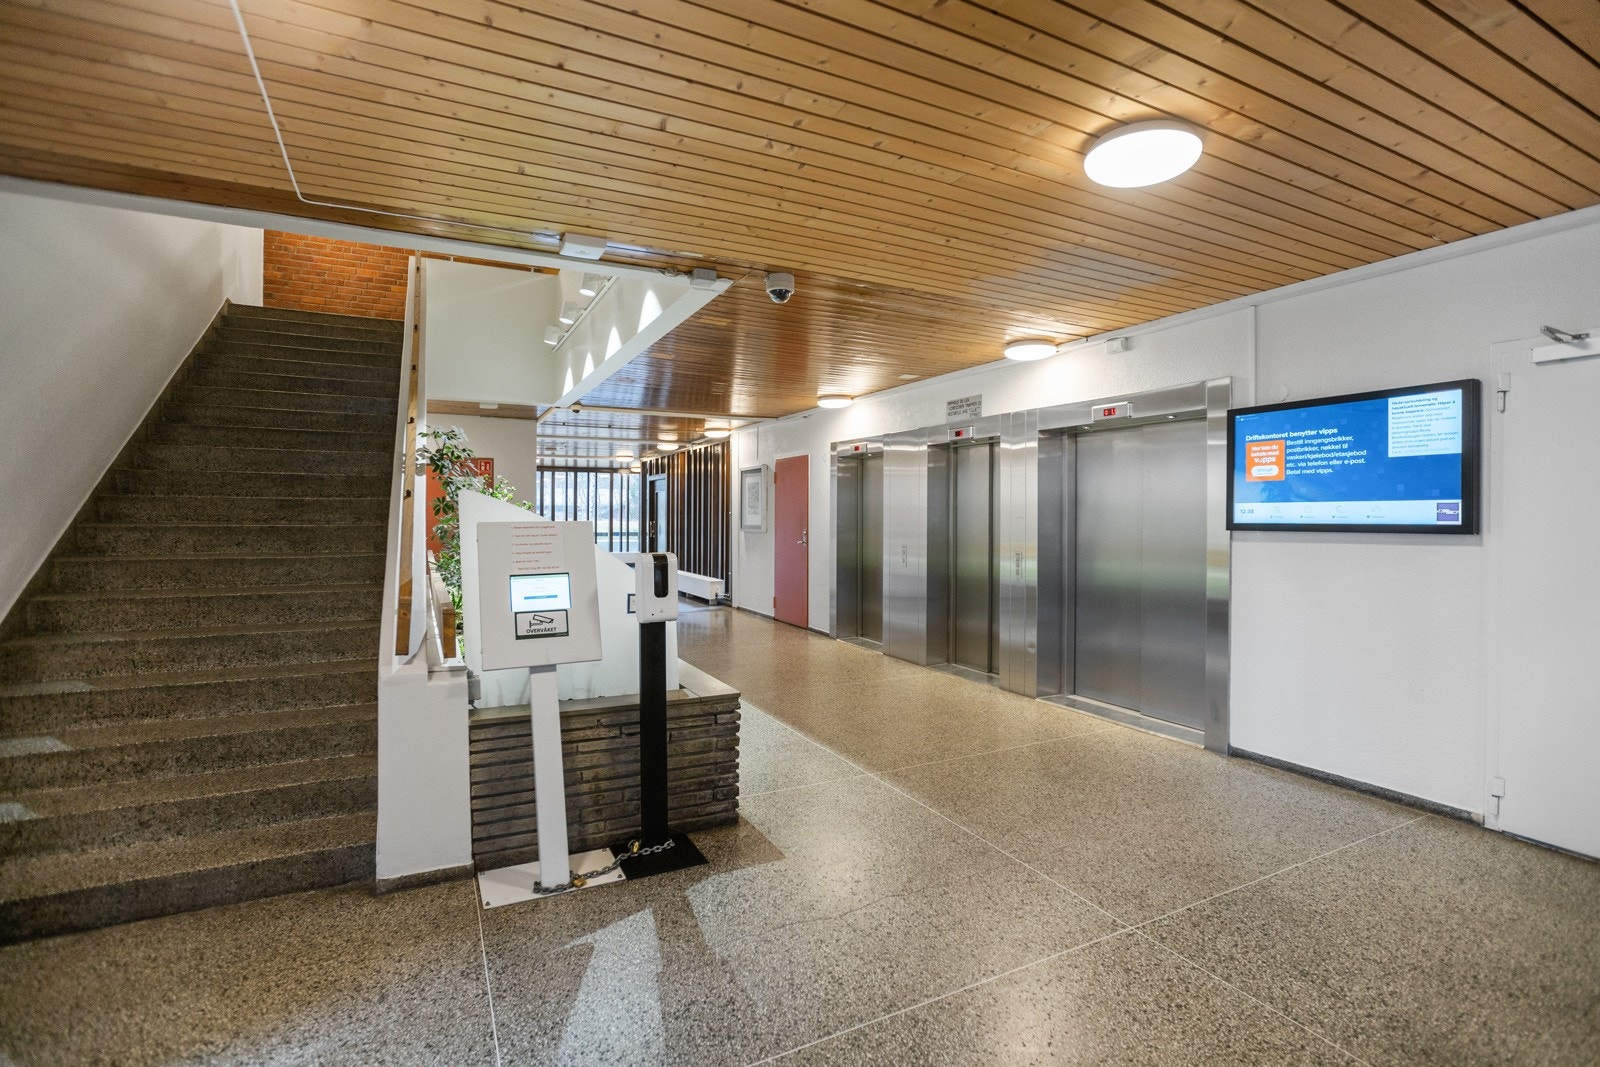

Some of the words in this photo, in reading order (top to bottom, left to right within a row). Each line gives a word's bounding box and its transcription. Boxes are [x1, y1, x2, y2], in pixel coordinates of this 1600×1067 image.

[1245, 432, 1288, 441] Driftskontoret
[1289, 429, 1317, 438] benytter
[1319, 427, 1338, 435] vipps
[1304, 435, 1354, 445] inngangsbrikker,
[1286, 446, 1319, 454] postbrikker,
